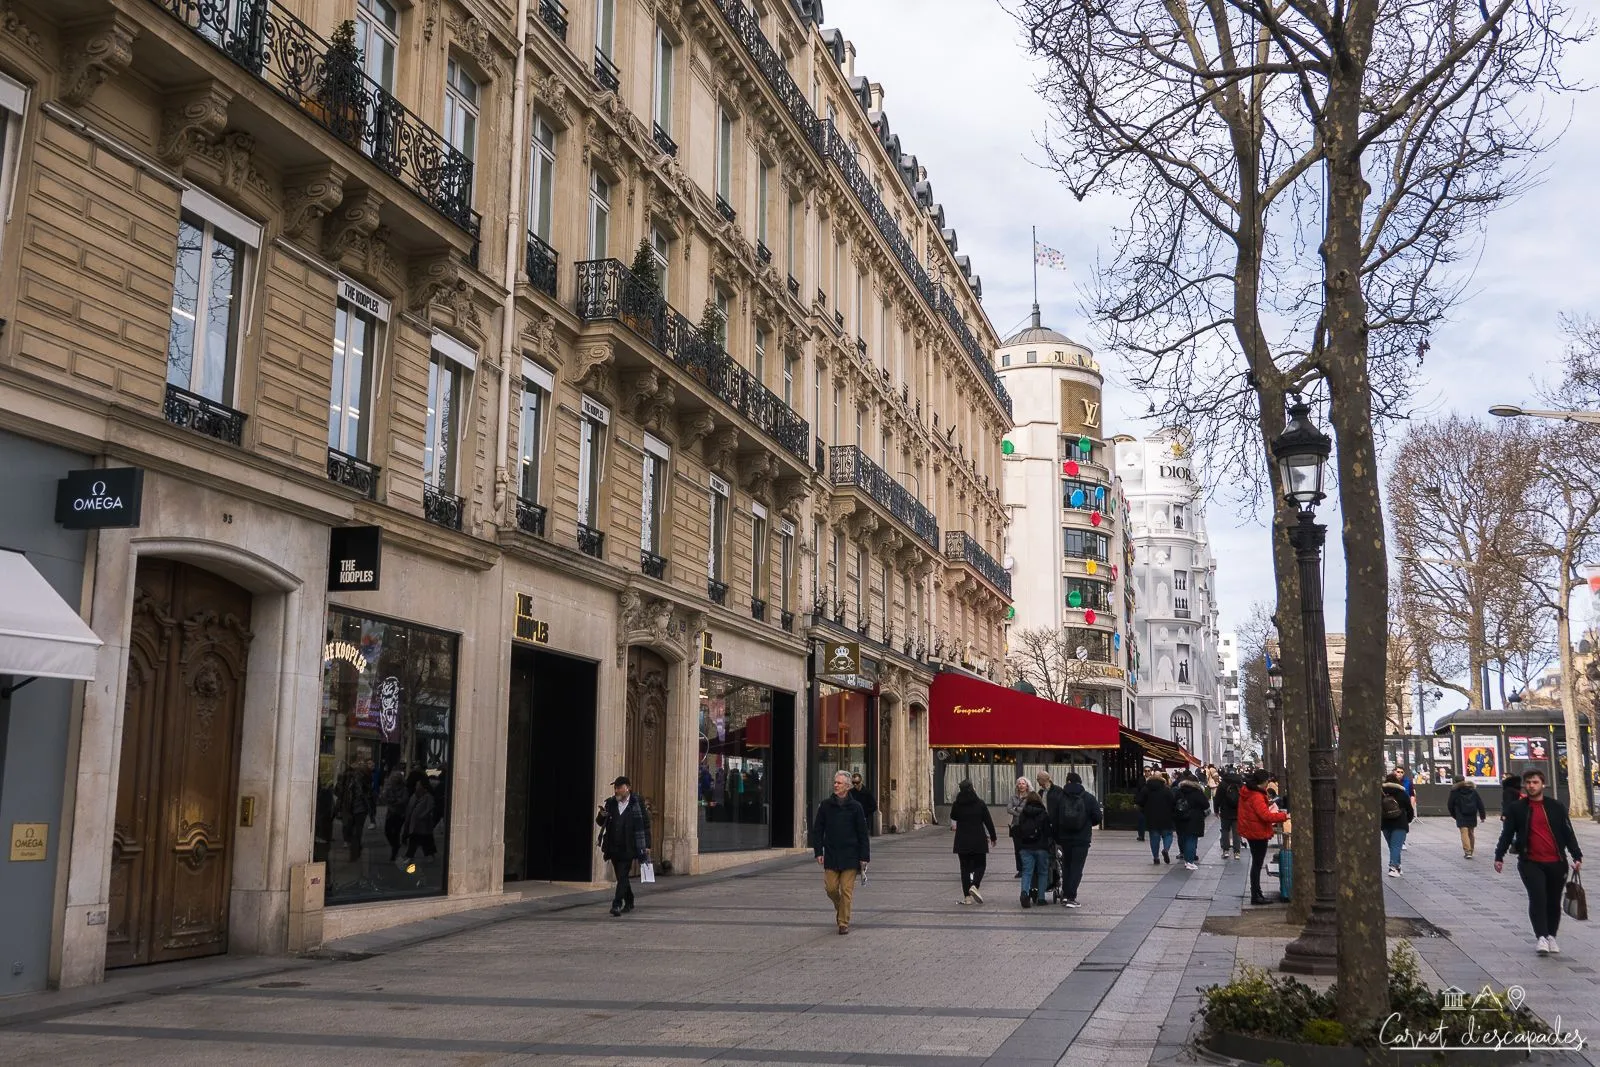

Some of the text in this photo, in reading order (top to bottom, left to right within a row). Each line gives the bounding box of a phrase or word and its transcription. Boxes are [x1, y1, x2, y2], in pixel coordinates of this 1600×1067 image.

[1160, 465, 1193, 482] DIOR
[73, 496, 124, 511] OMEGA
[340, 559, 356, 571] THE
[339, 570, 374, 583] KOOPLES
[14, 838, 45, 849] OMEGA
